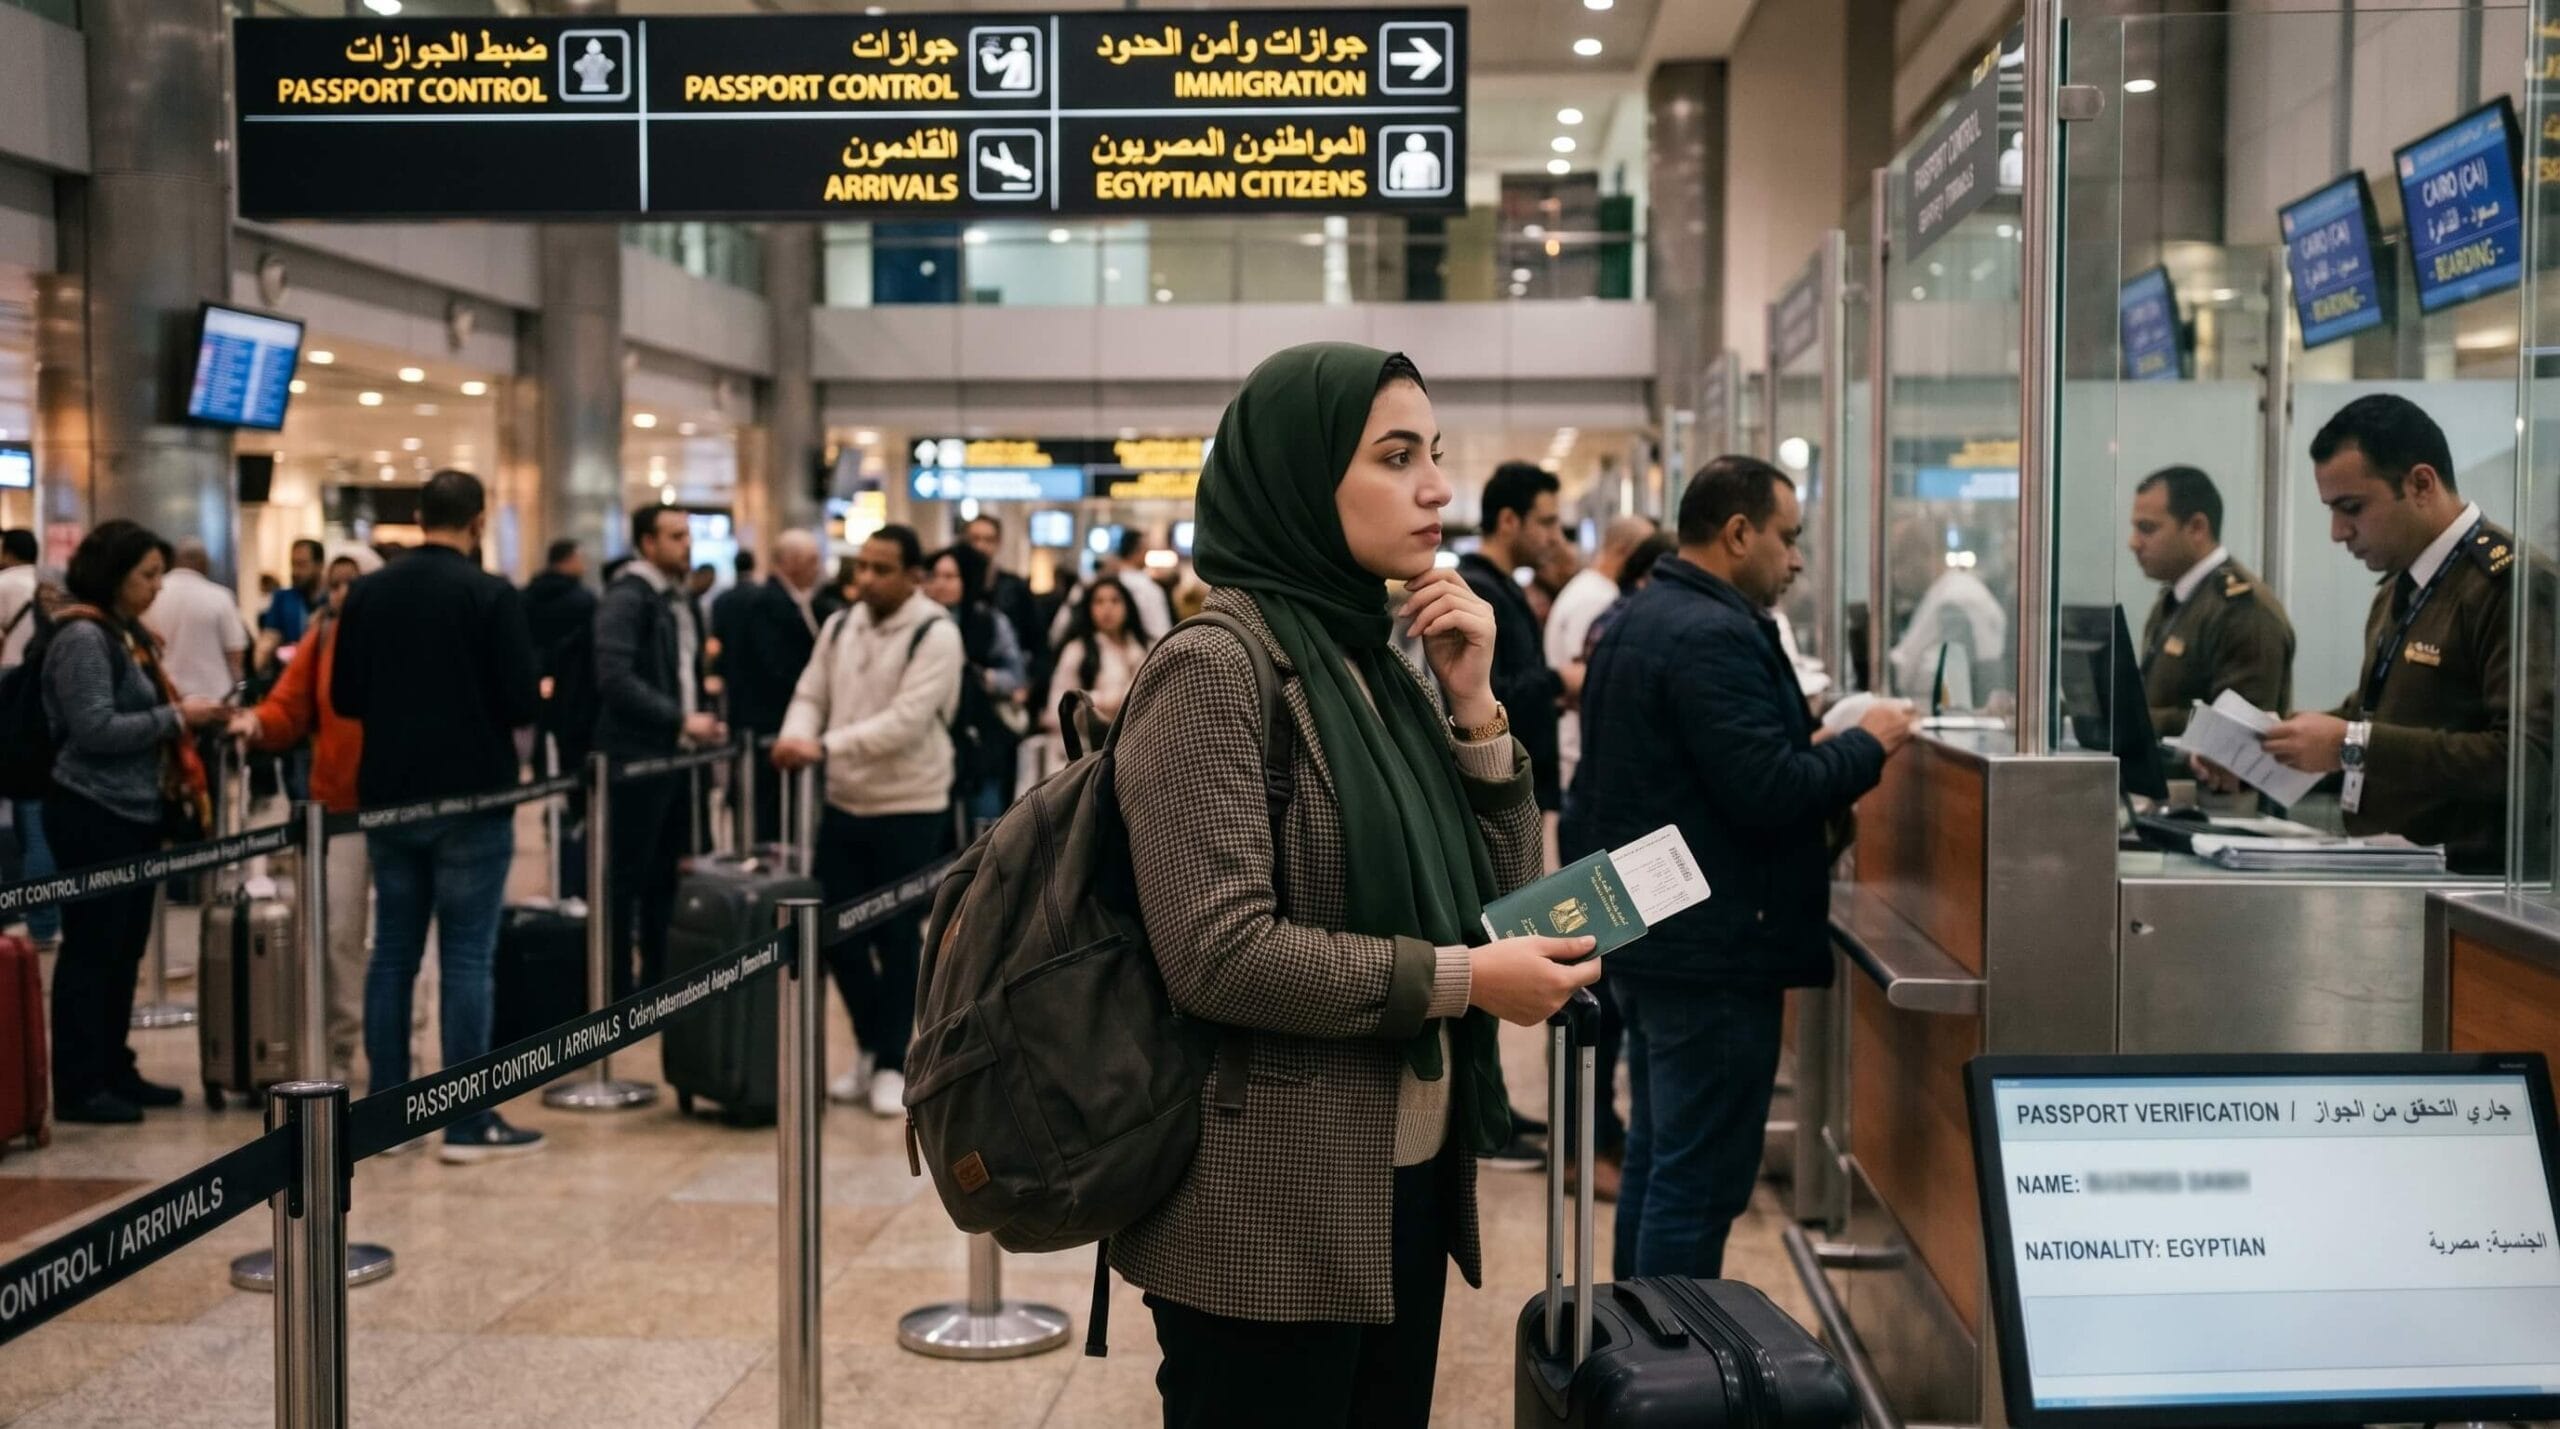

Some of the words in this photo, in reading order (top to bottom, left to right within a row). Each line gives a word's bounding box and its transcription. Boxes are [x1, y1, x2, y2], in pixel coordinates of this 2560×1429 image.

[346, 31, 468, 71] الجوازات
[474, 30, 548, 65] ضبط
[852, 30, 959, 67] جوازات
[1097, 26, 1183, 65] الحدود
[1190, 21, 1258, 64] وأمن
[1264, 27, 1368, 63] جوازات
[278, 77, 415, 104] PASSPORT
[418, 76, 548, 104] CONTROL
[685, 74, 825, 102] PASSPORT
[827, 73, 960, 102] CONTROL
[1174, 70, 1368, 98] IMMIGRATION
[842, 127, 959, 168] القادمون
[1091, 127, 1226, 166] المصريون
[1232, 124, 1367, 164] المواطنون
[823, 173, 959, 202] ARRIVALS
[1096, 170, 1237, 200] EGYPTIAN
[1240, 169, 1368, 199] CITIZENS
[25, 876, 81, 905] CONTROL
[87, 863, 136, 891] ARRIVALS
[406, 1068, 489, 1125] PASSPORT
[492, 1042, 555, 1090] CONTROL
[556, 1038, 562, 1064] /
[564, 1014, 621, 1060] ARRIVALS
[2017, 1102, 2129, 1125] PASSPORT
[2134, 1102, 2280, 1123] VERIFICATION
[2314, 1099, 2365, 1124] الجواز
[2373, 1102, 2397, 1123] من
[2403, 1098, 2458, 1124] التحقق
[2466, 1099, 2512, 1125] جاري
[2017, 1174, 2081, 1194] NAME:
[107, 1230, 115, 1267] /
[119, 1176, 223, 1260] ARRIVALS
[2025, 1239, 2161, 1260] NATIONALITY:
[2167, 1238, 2266, 1258] EGYPTIAN
[2429, 1231, 2480, 1255] مصرية
[2486, 1230, 2547, 1254] الجنسية:
